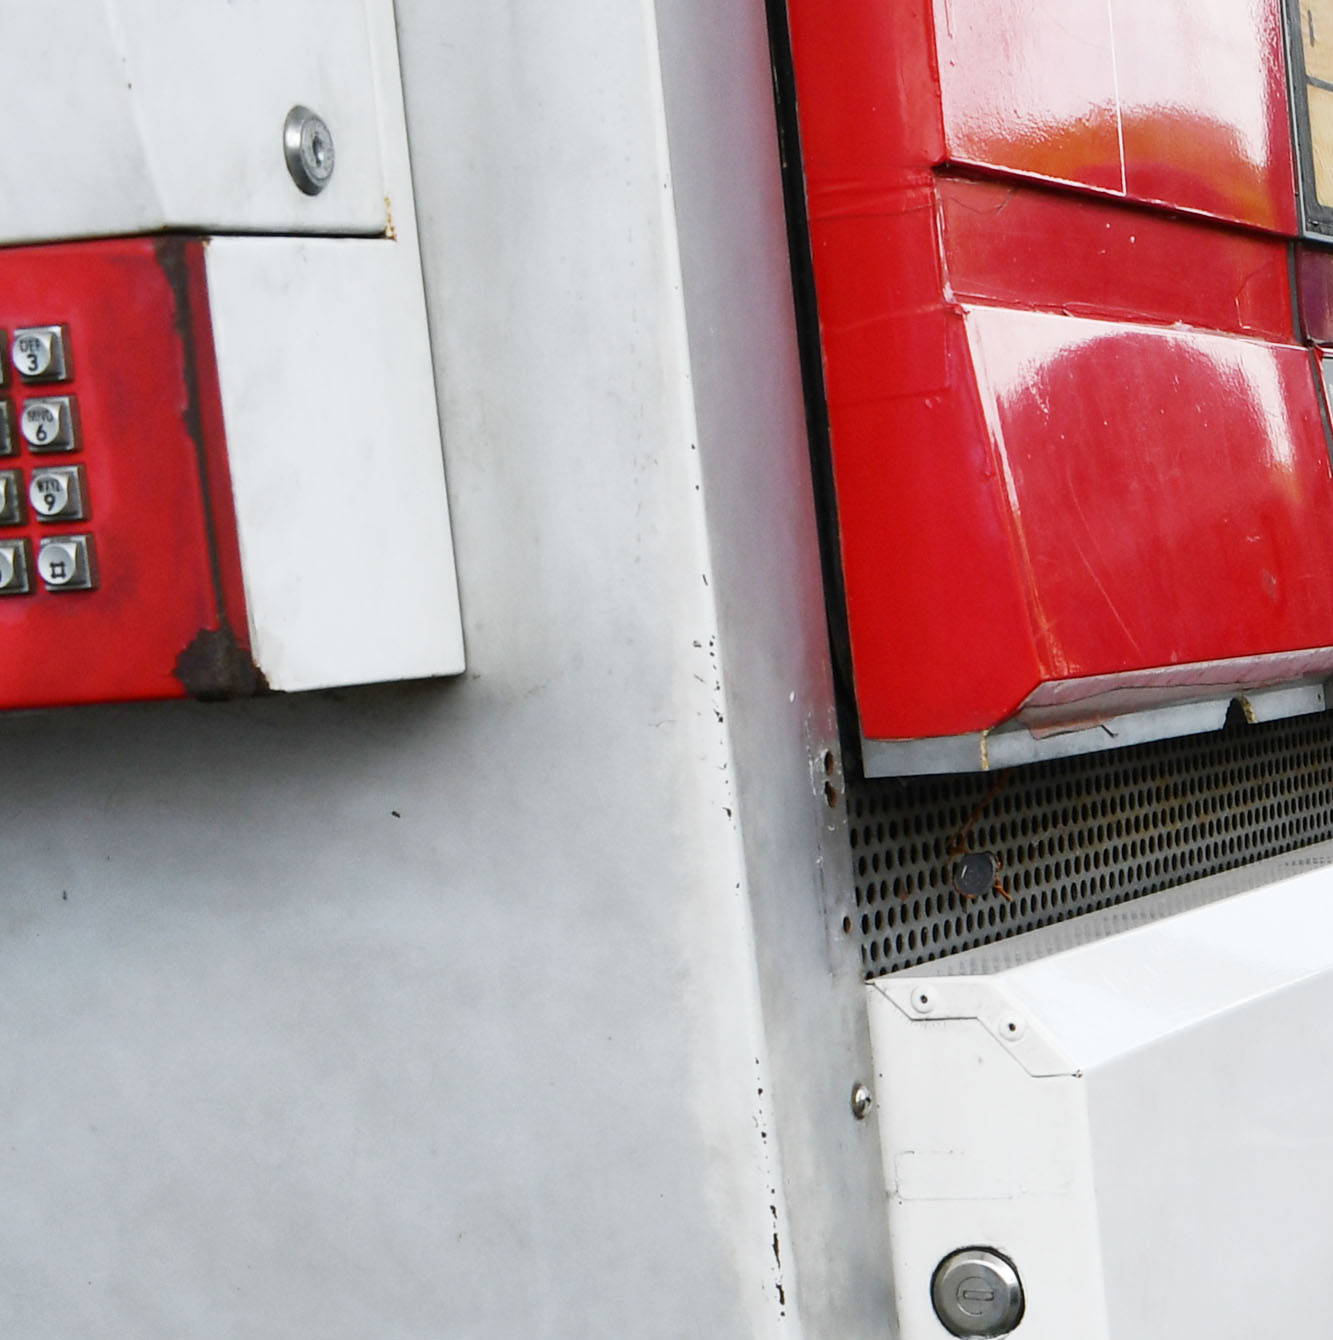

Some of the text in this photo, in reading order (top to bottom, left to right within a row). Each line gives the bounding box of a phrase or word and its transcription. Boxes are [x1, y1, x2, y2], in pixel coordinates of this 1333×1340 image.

[26, 354, 38, 372] 3
[36, 424, 47, 441] 6
[44, 494, 55, 512] 9
